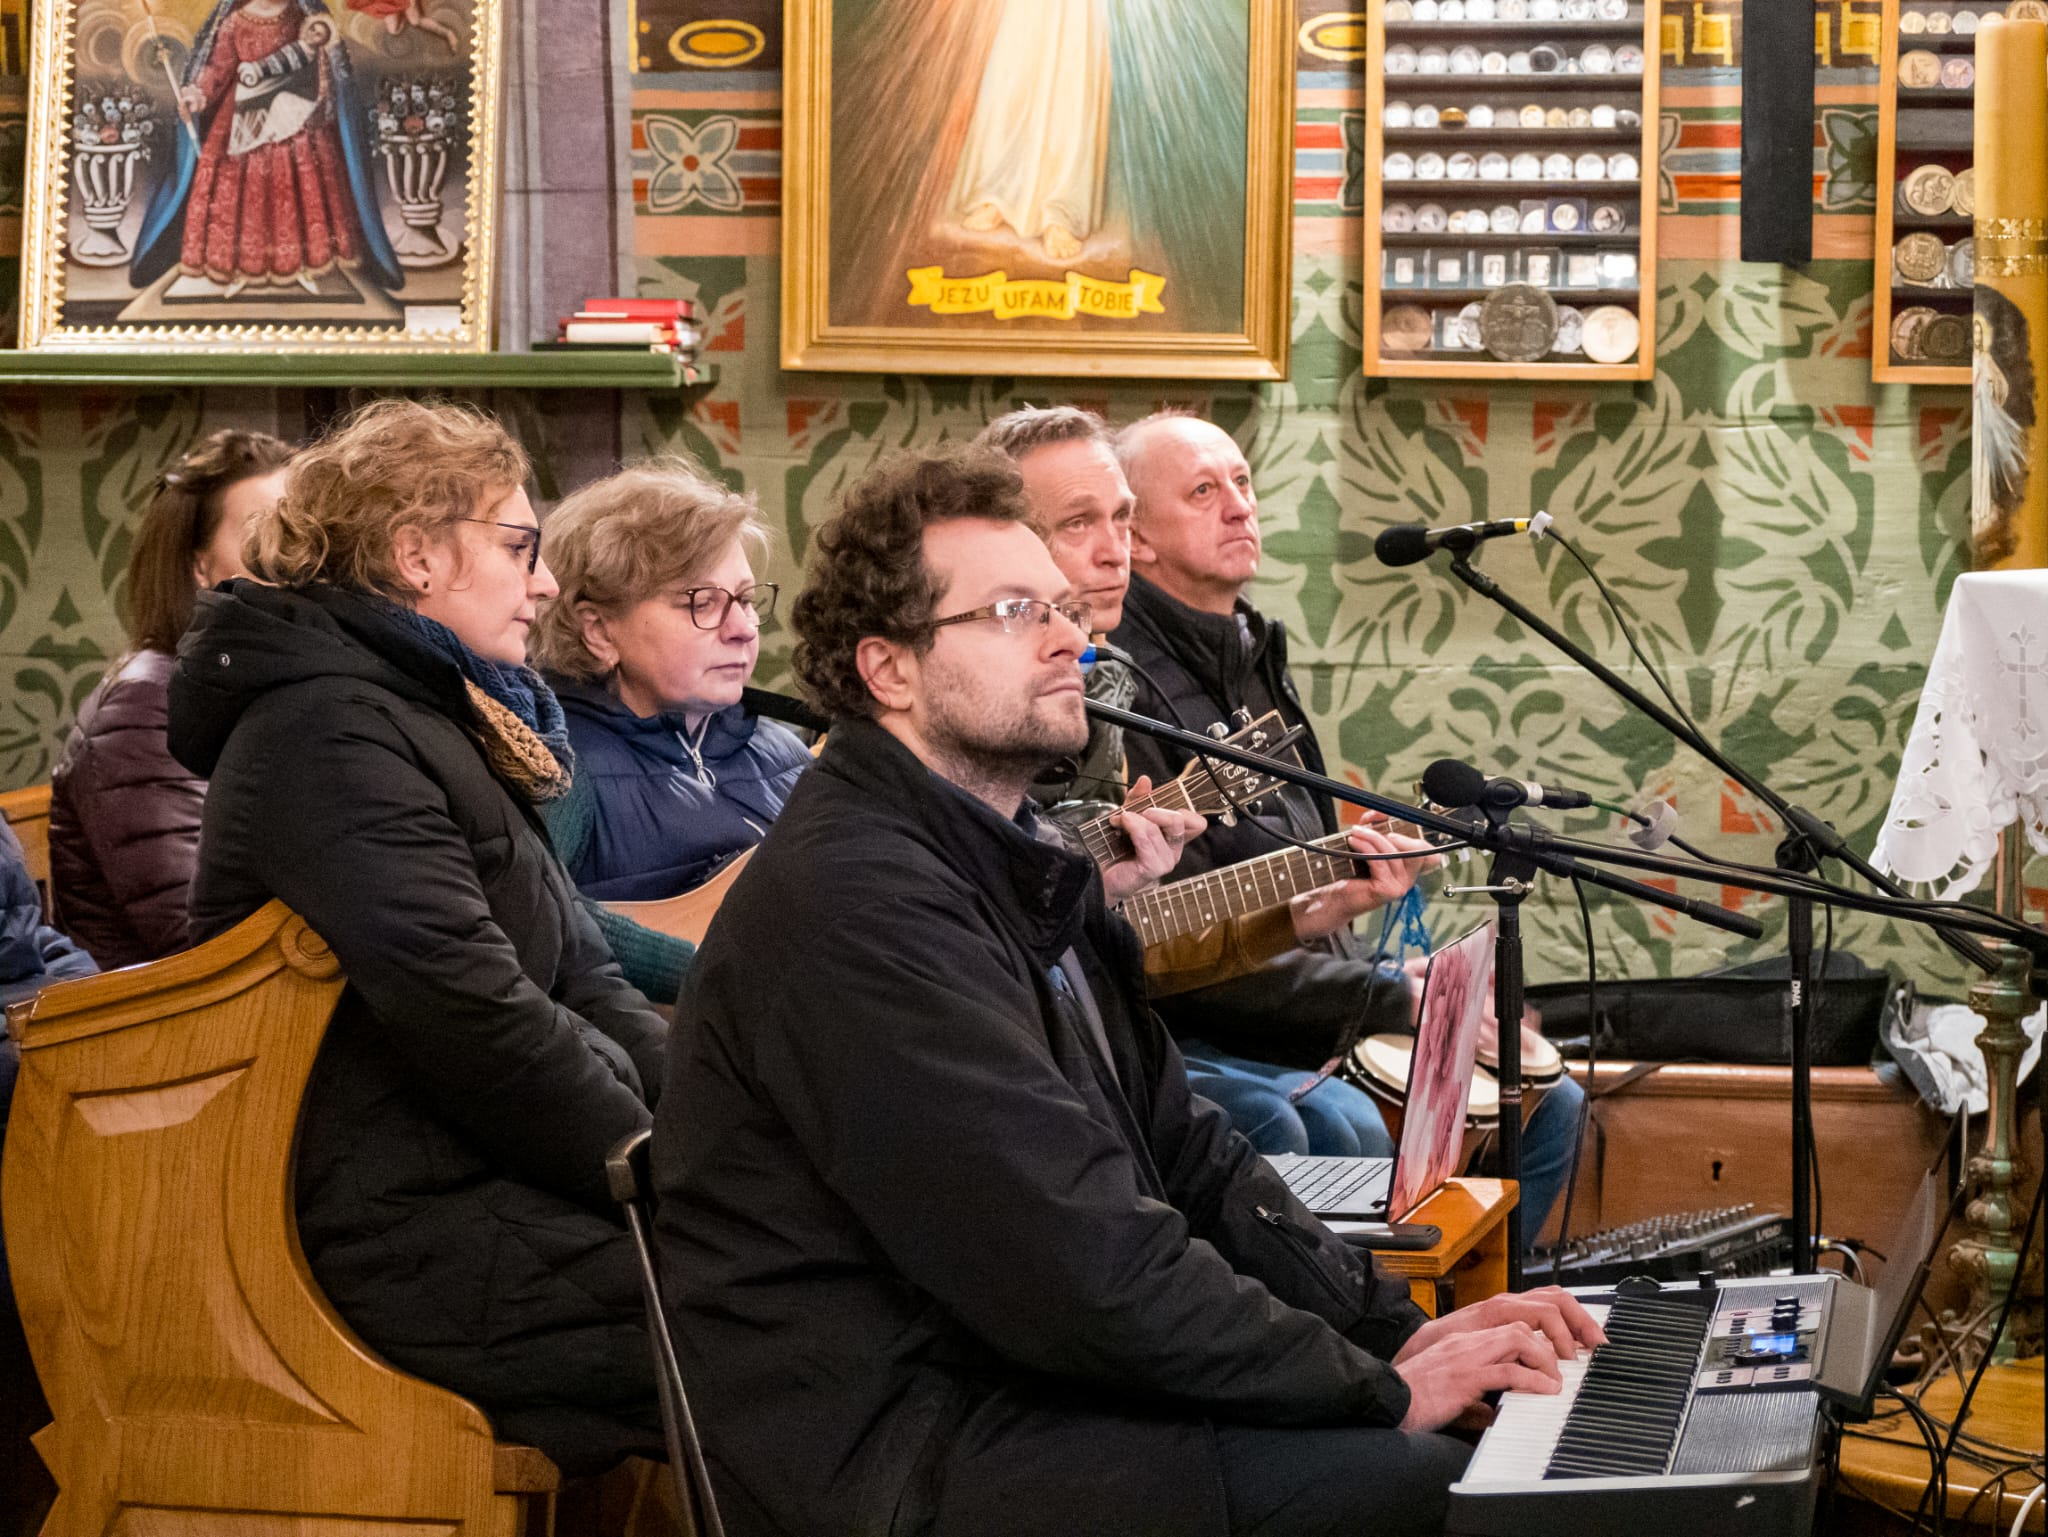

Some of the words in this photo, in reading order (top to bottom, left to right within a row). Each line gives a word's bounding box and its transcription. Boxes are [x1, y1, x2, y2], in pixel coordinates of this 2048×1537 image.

[936, 284, 990, 304] JEZU
[1003, 290, 1066, 311] UFAM
[1079, 285, 1134, 311] TOBIE
[1791, 980, 1801, 1007] DNA
